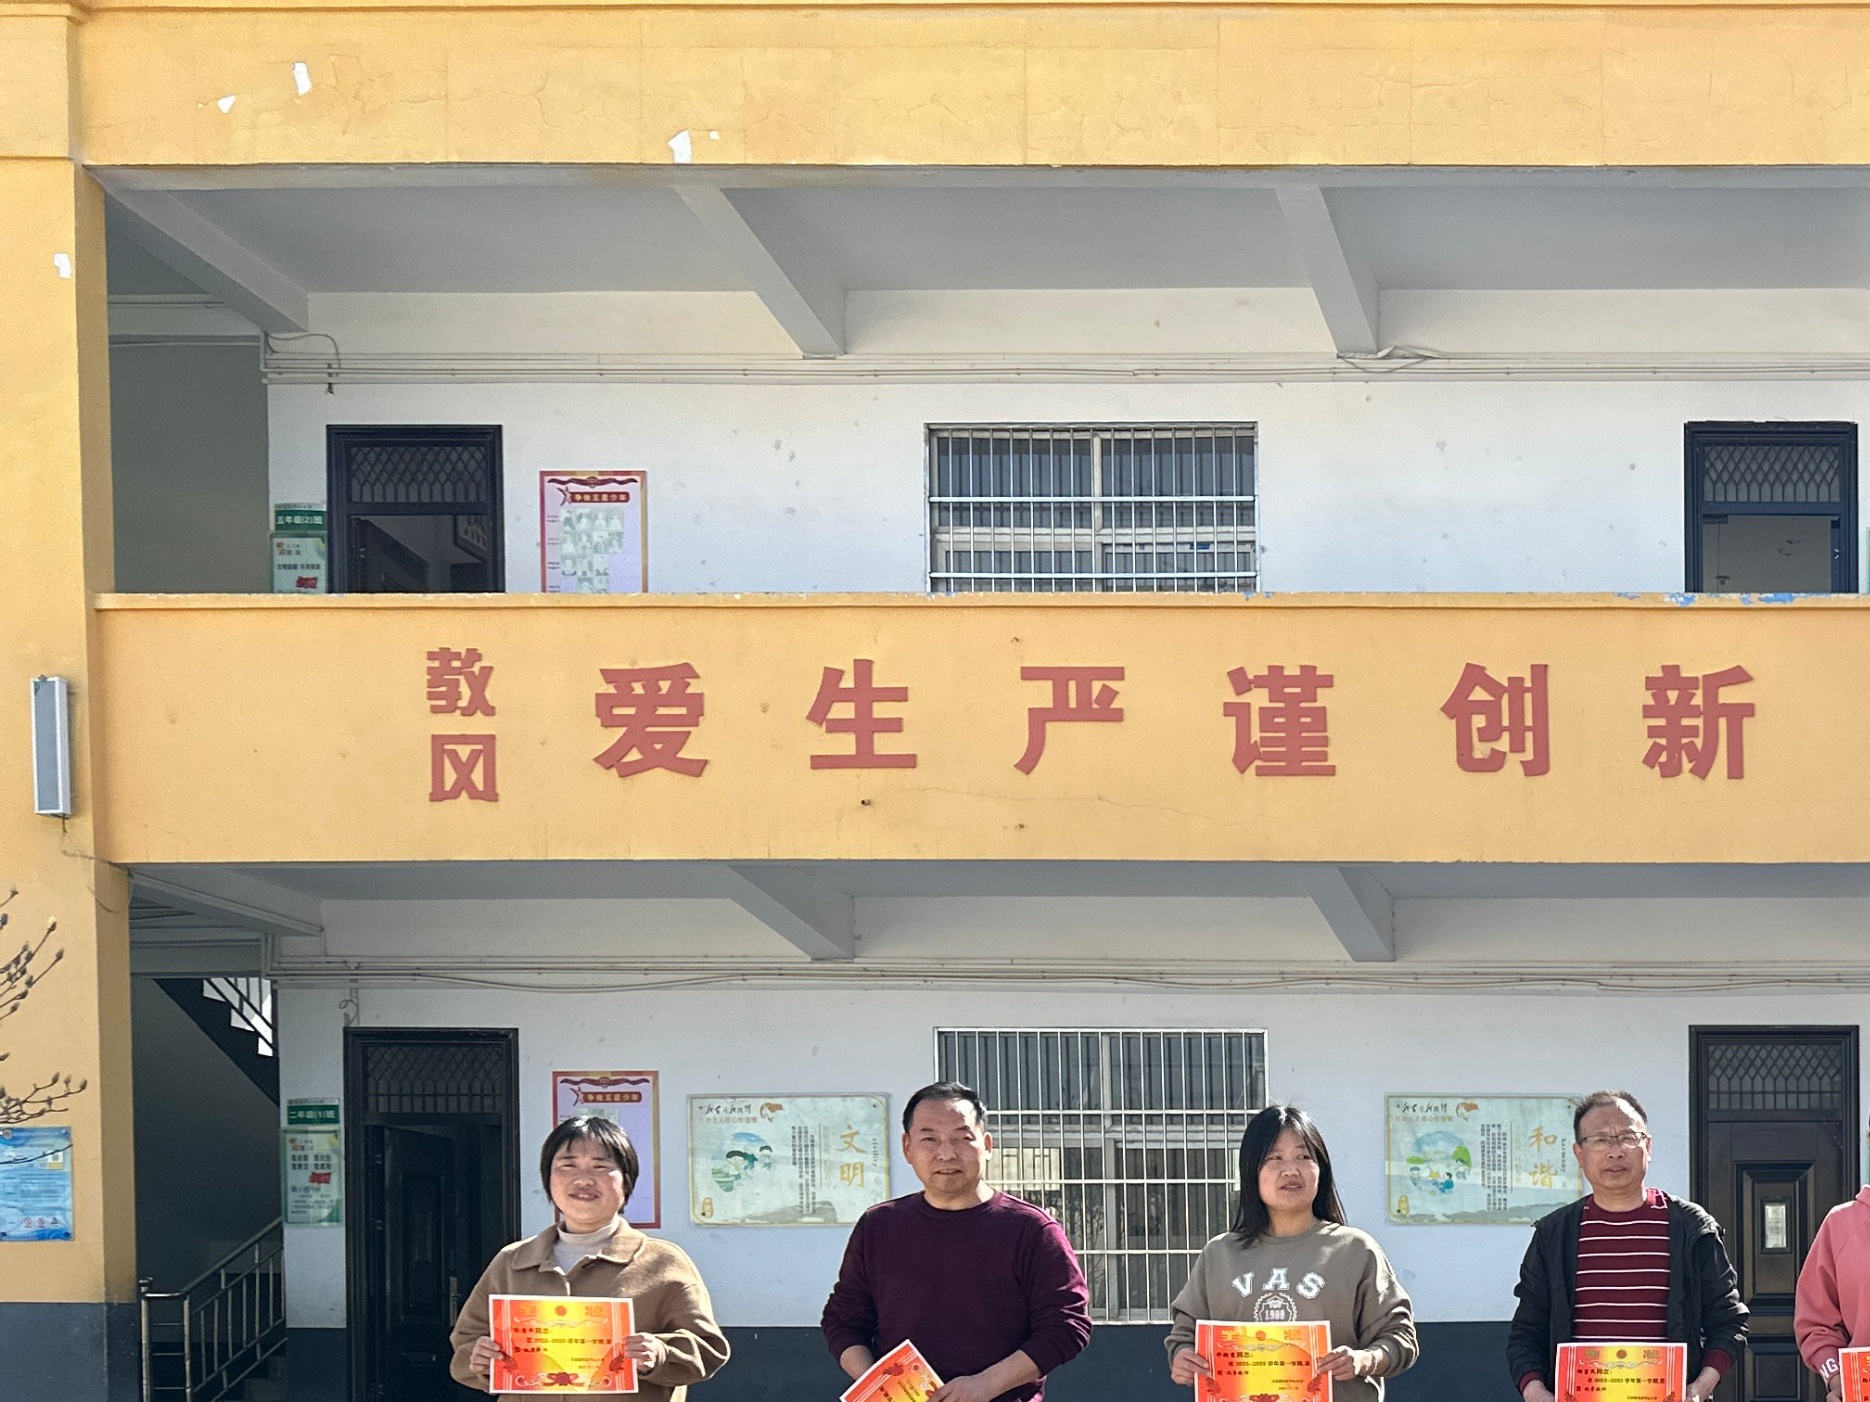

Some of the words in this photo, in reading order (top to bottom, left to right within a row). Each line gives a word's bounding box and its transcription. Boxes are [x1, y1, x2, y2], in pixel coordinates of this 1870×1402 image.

[426, 647, 499, 803] 教风
[594, 658, 1755, 780] 爱生严谨创新
[289, 1110, 336, 1119] 二年级(1)班
[837, 1123, 868, 1188] 文明
[1528, 1126, 1559, 1189] 和谐
[1232, 1267, 1325, 1299] VAS
